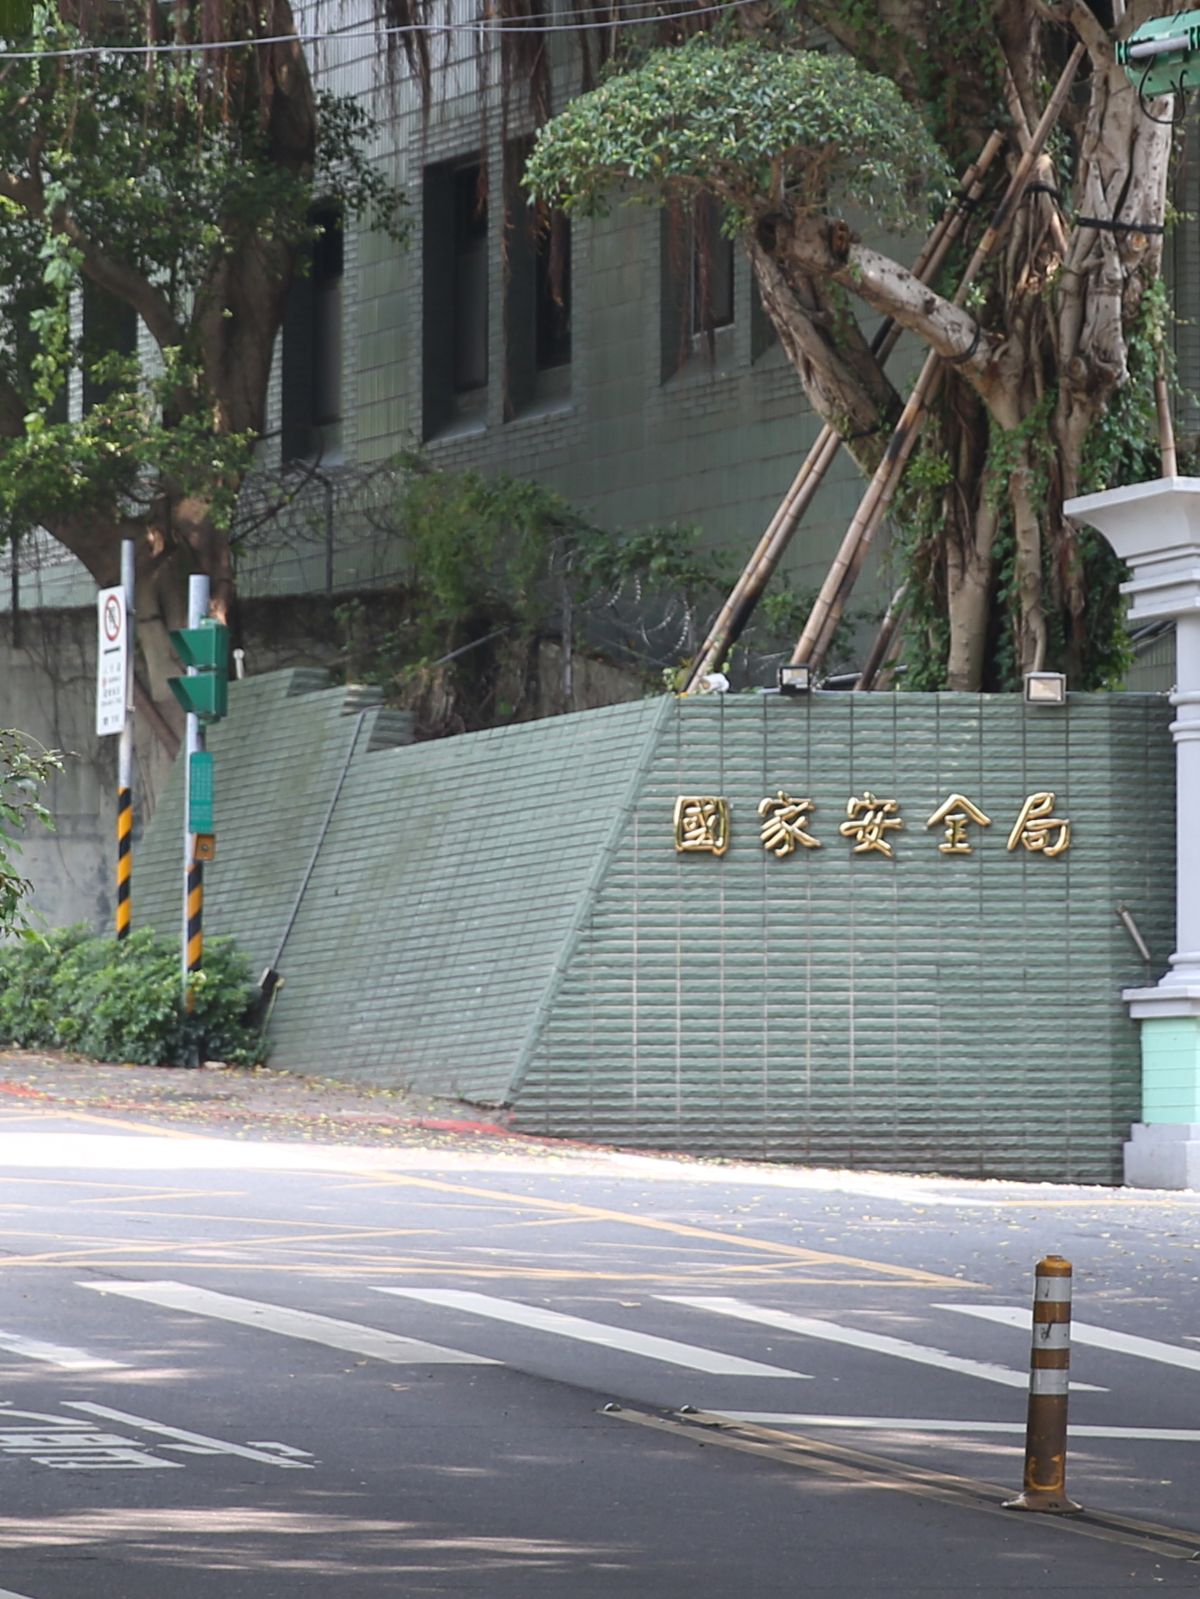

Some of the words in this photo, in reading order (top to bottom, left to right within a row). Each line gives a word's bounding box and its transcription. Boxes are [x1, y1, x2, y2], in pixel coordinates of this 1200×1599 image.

[673, 791, 1071, 857] 國家安全局
